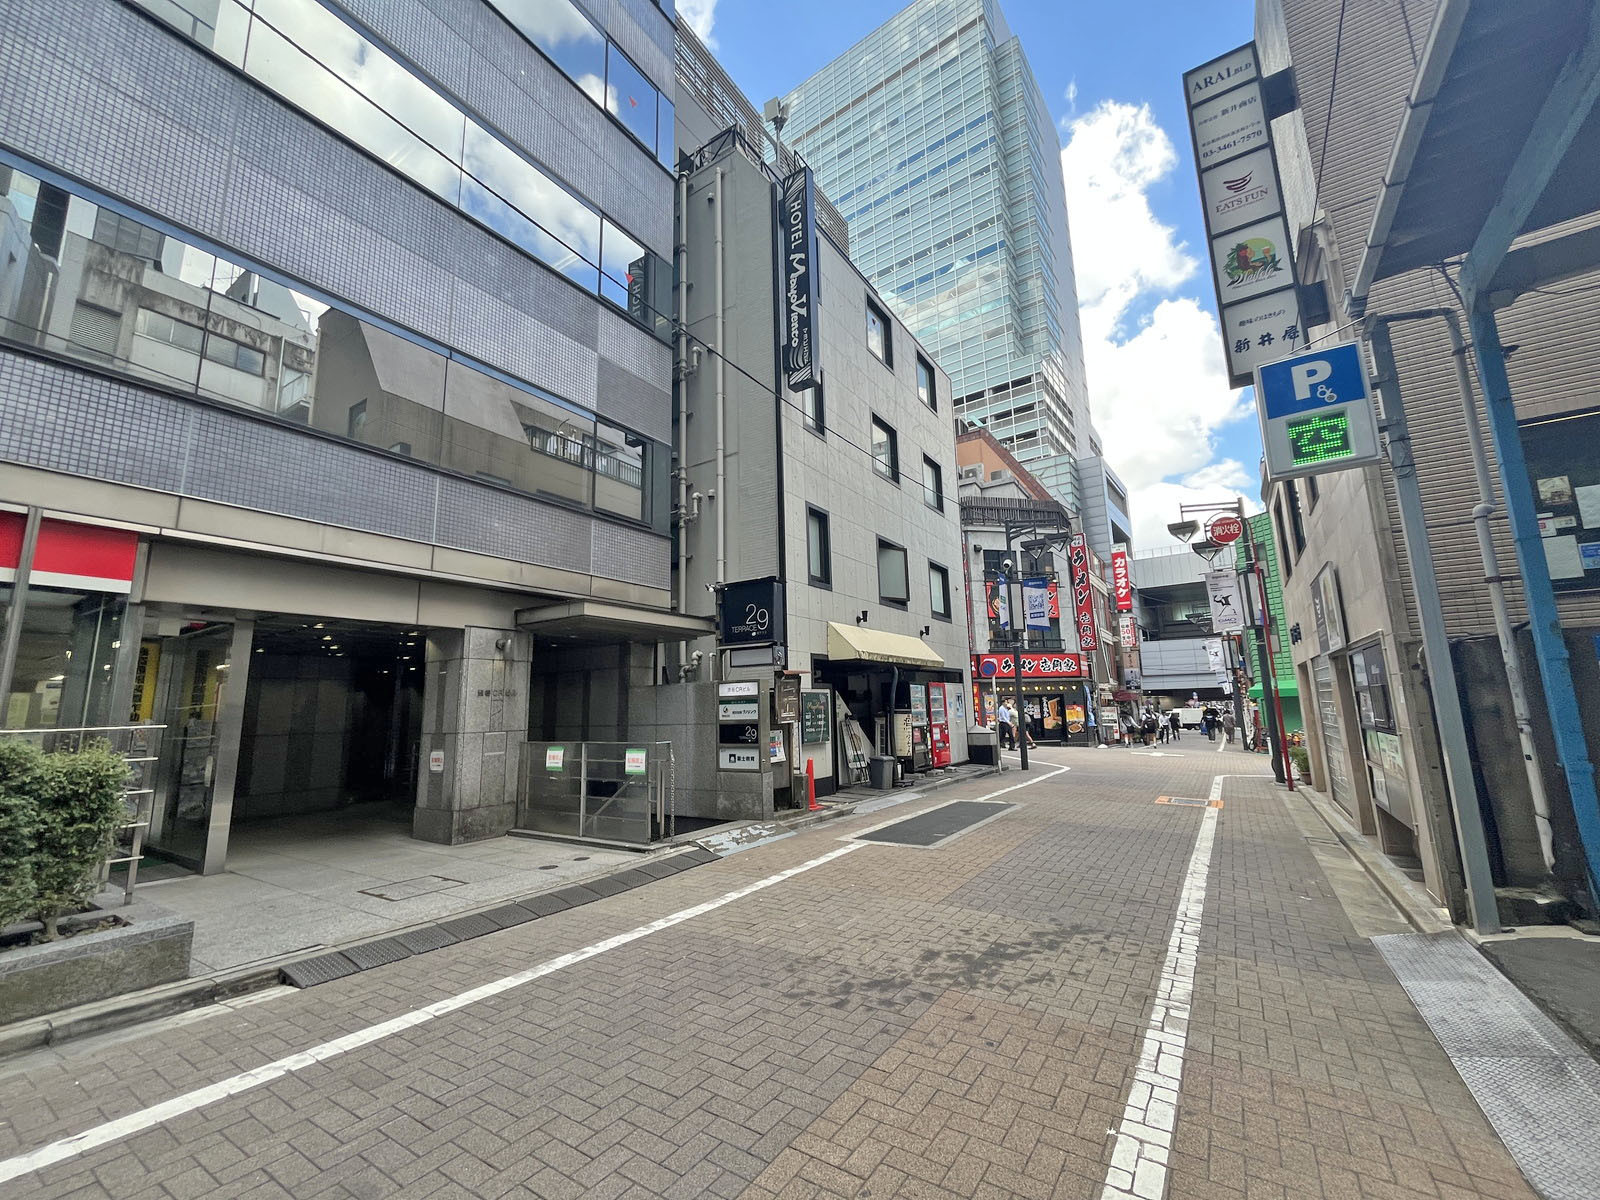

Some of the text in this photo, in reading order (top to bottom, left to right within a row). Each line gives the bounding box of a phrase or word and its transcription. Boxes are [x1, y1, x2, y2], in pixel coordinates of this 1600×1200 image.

[1193, 67, 1231, 94] ARAI
[1202, 130, 1262, 159] 03-3461-7570
[1215, 197, 1242, 214] EATS
[1245, 187, 1269, 202] FUN
[789, 199, 803, 250] HOTEL
[1291, 360, 1332, 400] P
[1289, 417, 1353, 466] 空
[1213, 523, 1240, 537] 消火栓
[1072, 548, 1090, 607] ラーメン
[745, 603, 769, 630] 29
[745, 725, 757, 740] 29
